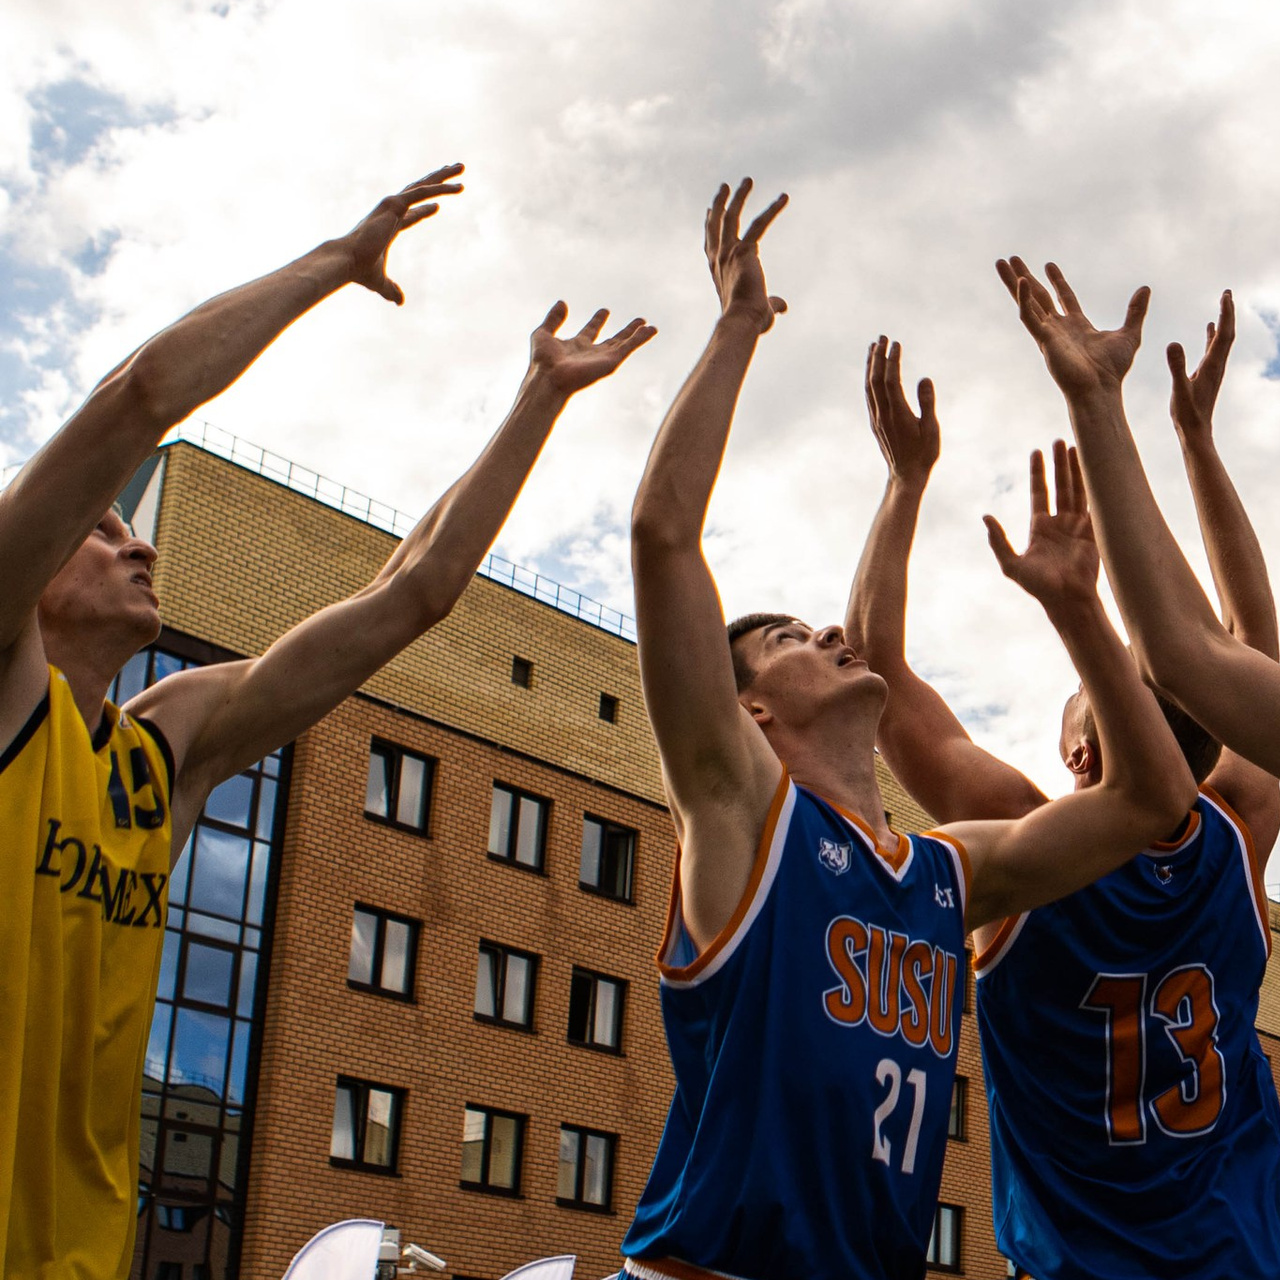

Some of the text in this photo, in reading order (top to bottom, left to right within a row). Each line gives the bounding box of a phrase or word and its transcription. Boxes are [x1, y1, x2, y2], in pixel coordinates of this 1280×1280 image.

[823, 915, 957, 1058] SUSU
[1079, 963, 1226, 1146] 13
[872, 1058, 926, 1174] 21
